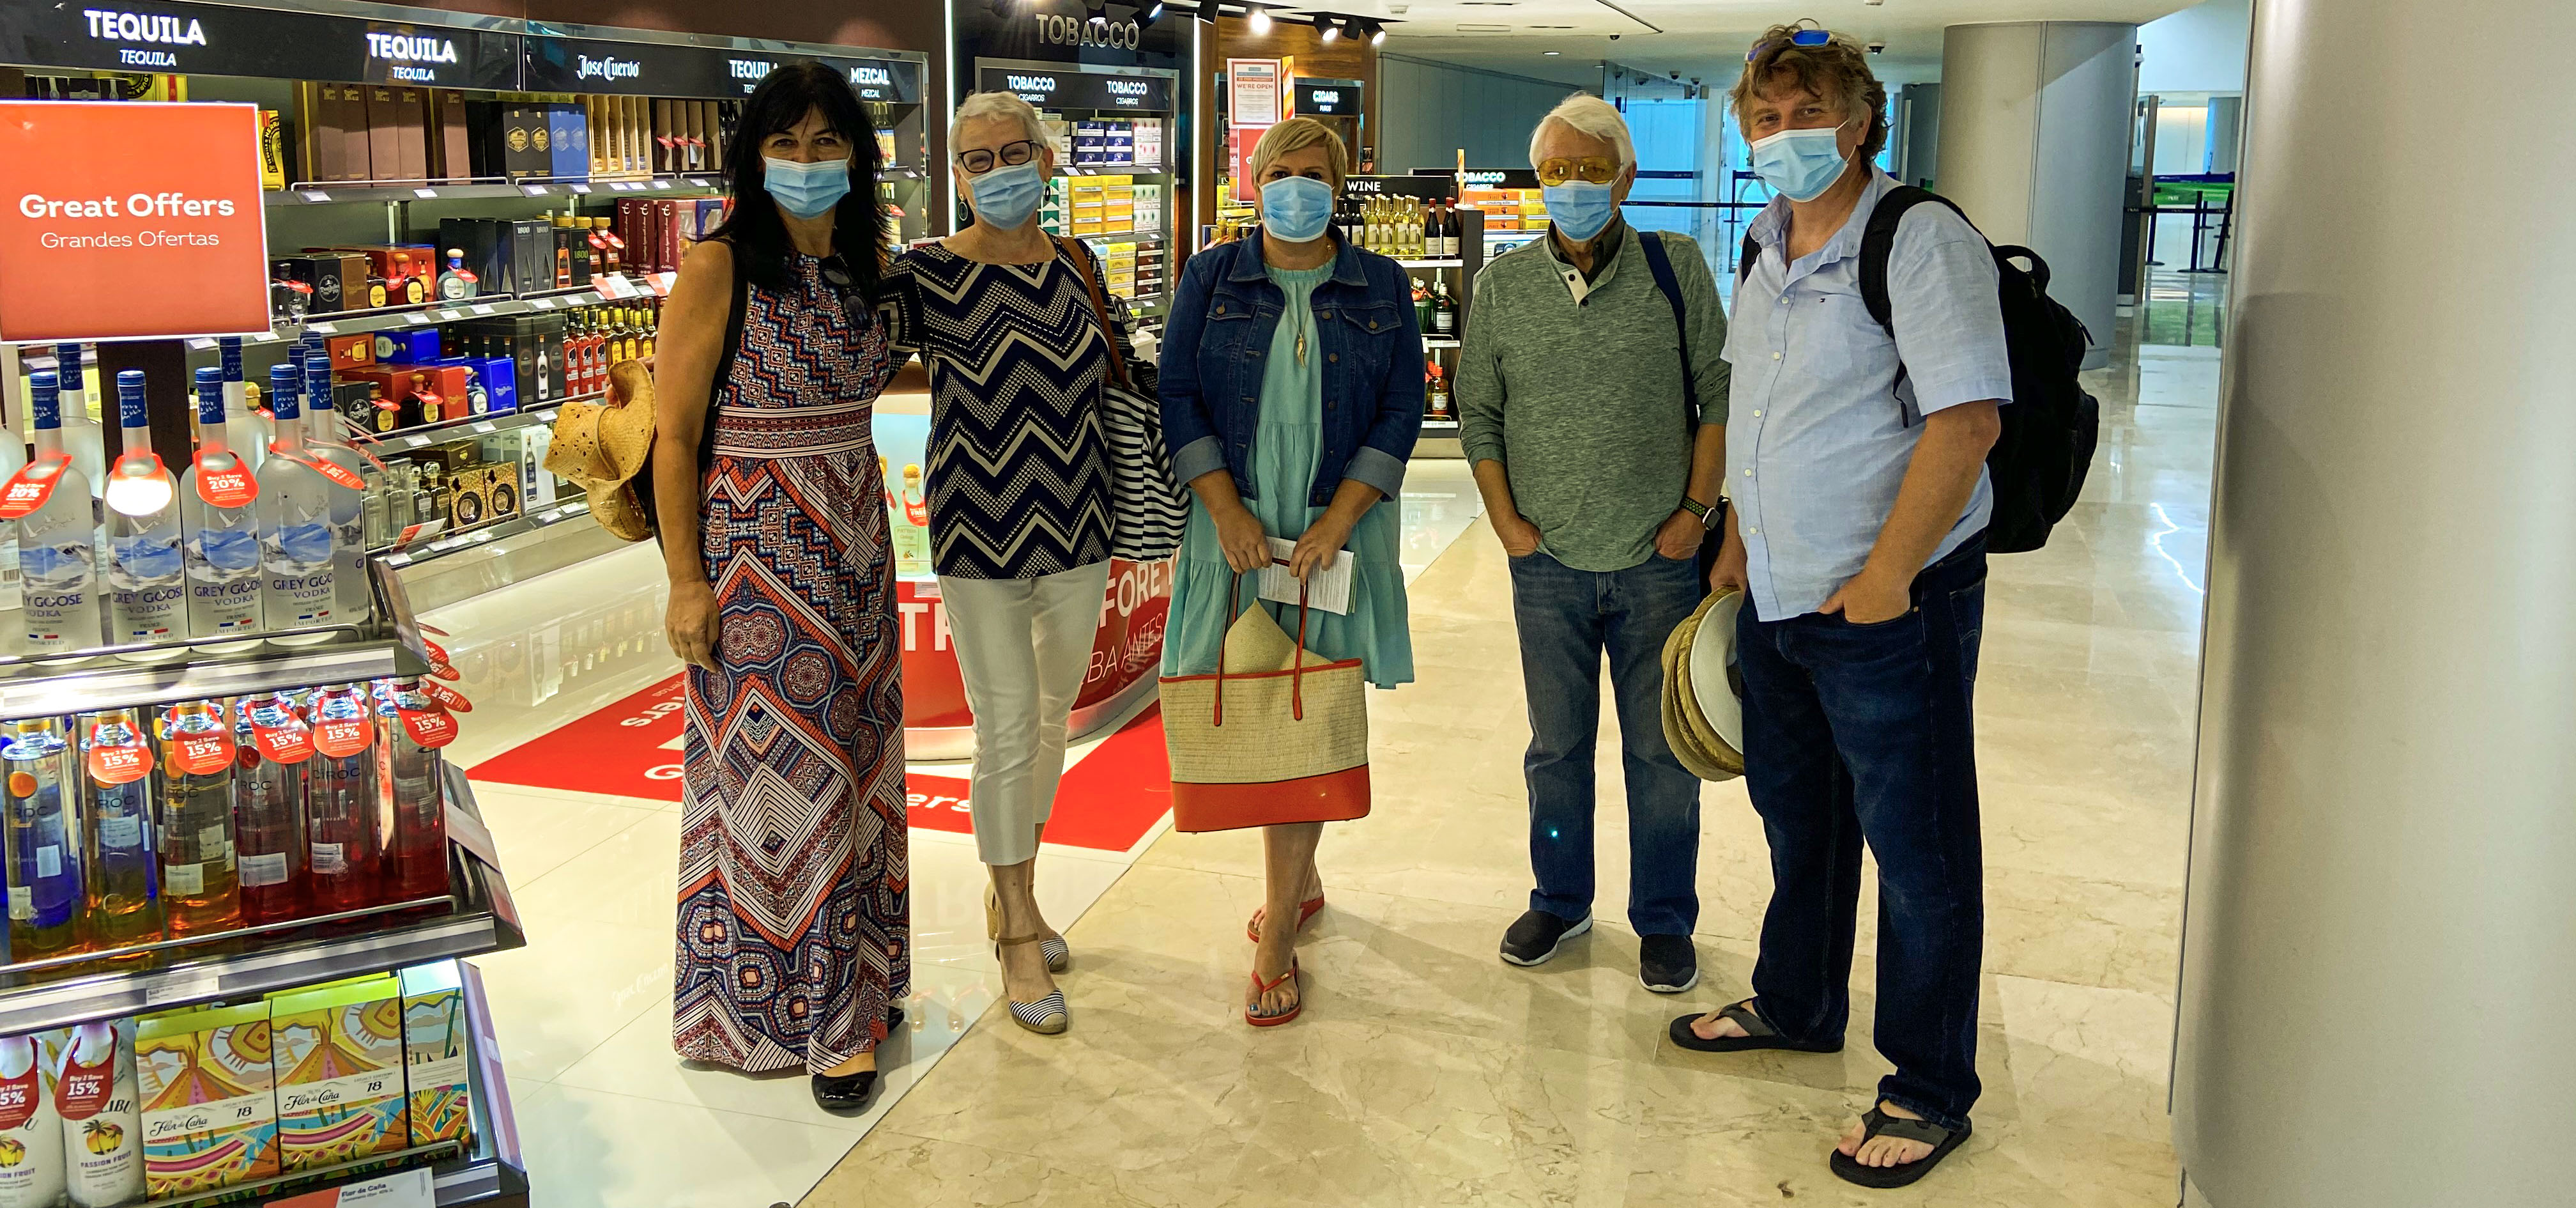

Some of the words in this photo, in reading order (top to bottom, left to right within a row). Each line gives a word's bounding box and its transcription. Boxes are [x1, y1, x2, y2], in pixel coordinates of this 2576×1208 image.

[83, 9, 207, 46] TEQUILA
[1035, 13, 1140, 50] TOBACCO
[366, 33, 457, 63] TEQUILA
[119, 49, 176, 66] TEQUILA
[392, 66, 435, 81] TEQUILA
[577, 54, 602, 81] Jose
[603, 56, 639, 81] Cuervo
[850, 67, 890, 85] MEZCAL
[1007, 75, 1055, 91] TOBACCO
[861, 89, 880, 98] MEZCAL
[1106, 81, 1147, 95] TOBACCO
[1018, 93, 1045, 102] CIGARROS
[1116, 97, 1138, 105] CIGARROS
[1313, 90, 1339, 103] CIGARS
[1455, 172, 1506, 183] TOBACCO
[1347, 180, 1381, 192] WINE
[19, 194, 119, 219] Great
[126, 192, 235, 218] Offers
[40, 231, 133, 249] Grandes
[138, 230, 220, 247] Ofertas
[574, 250, 588, 259] 1800
[209, 478, 245, 490] 20%
[6, 488, 40, 497] 20%
[194, 585, 226, 597] GREY
[230, 578, 262, 594] GOOS
[273, 578, 304, 590] GREY
[309, 573, 332, 587] GOO
[34, 593, 83, 607] GOOSE
[112, 592, 138, 604] GREY
[142, 585, 184, 603] GOOSE
[214, 594, 254, 606] VODKA
[294, 587, 331, 598] VODKA
[1099, 562, 1160, 628] FORE
[128, 604, 171, 614] VODKA
[1121, 612, 1163, 669] ANTES
[620, 697, 685, 727] ers
[415, 716, 447, 732] 15%
[269, 732, 303, 748] 15%
[327, 727, 360, 740] 15%
[186, 741, 222, 757] 15%
[103, 754, 139, 767] 15%
[240, 780, 272, 791] ROC
[906, 791, 971, 812] ers
[67, 1081, 100, 1096] 15%
[366, 1081, 382, 1092] 18
[0, 1091, 26, 1106] 5%
[284, 1094, 310, 1110] Flor
[318, 1089, 341, 1106] Caña
[101, 1099, 134, 1114] IBU
[236, 1106, 252, 1119] 18
[149, 1120, 177, 1136] Flor
[185, 1115, 208, 1133] Caña
[80, 1158, 111, 1168] PASSION
[113, 1150, 132, 1163] FRUIT
[14, 1168, 35, 1177] FRUIT
[367, 1183, 387, 1191] Caña
